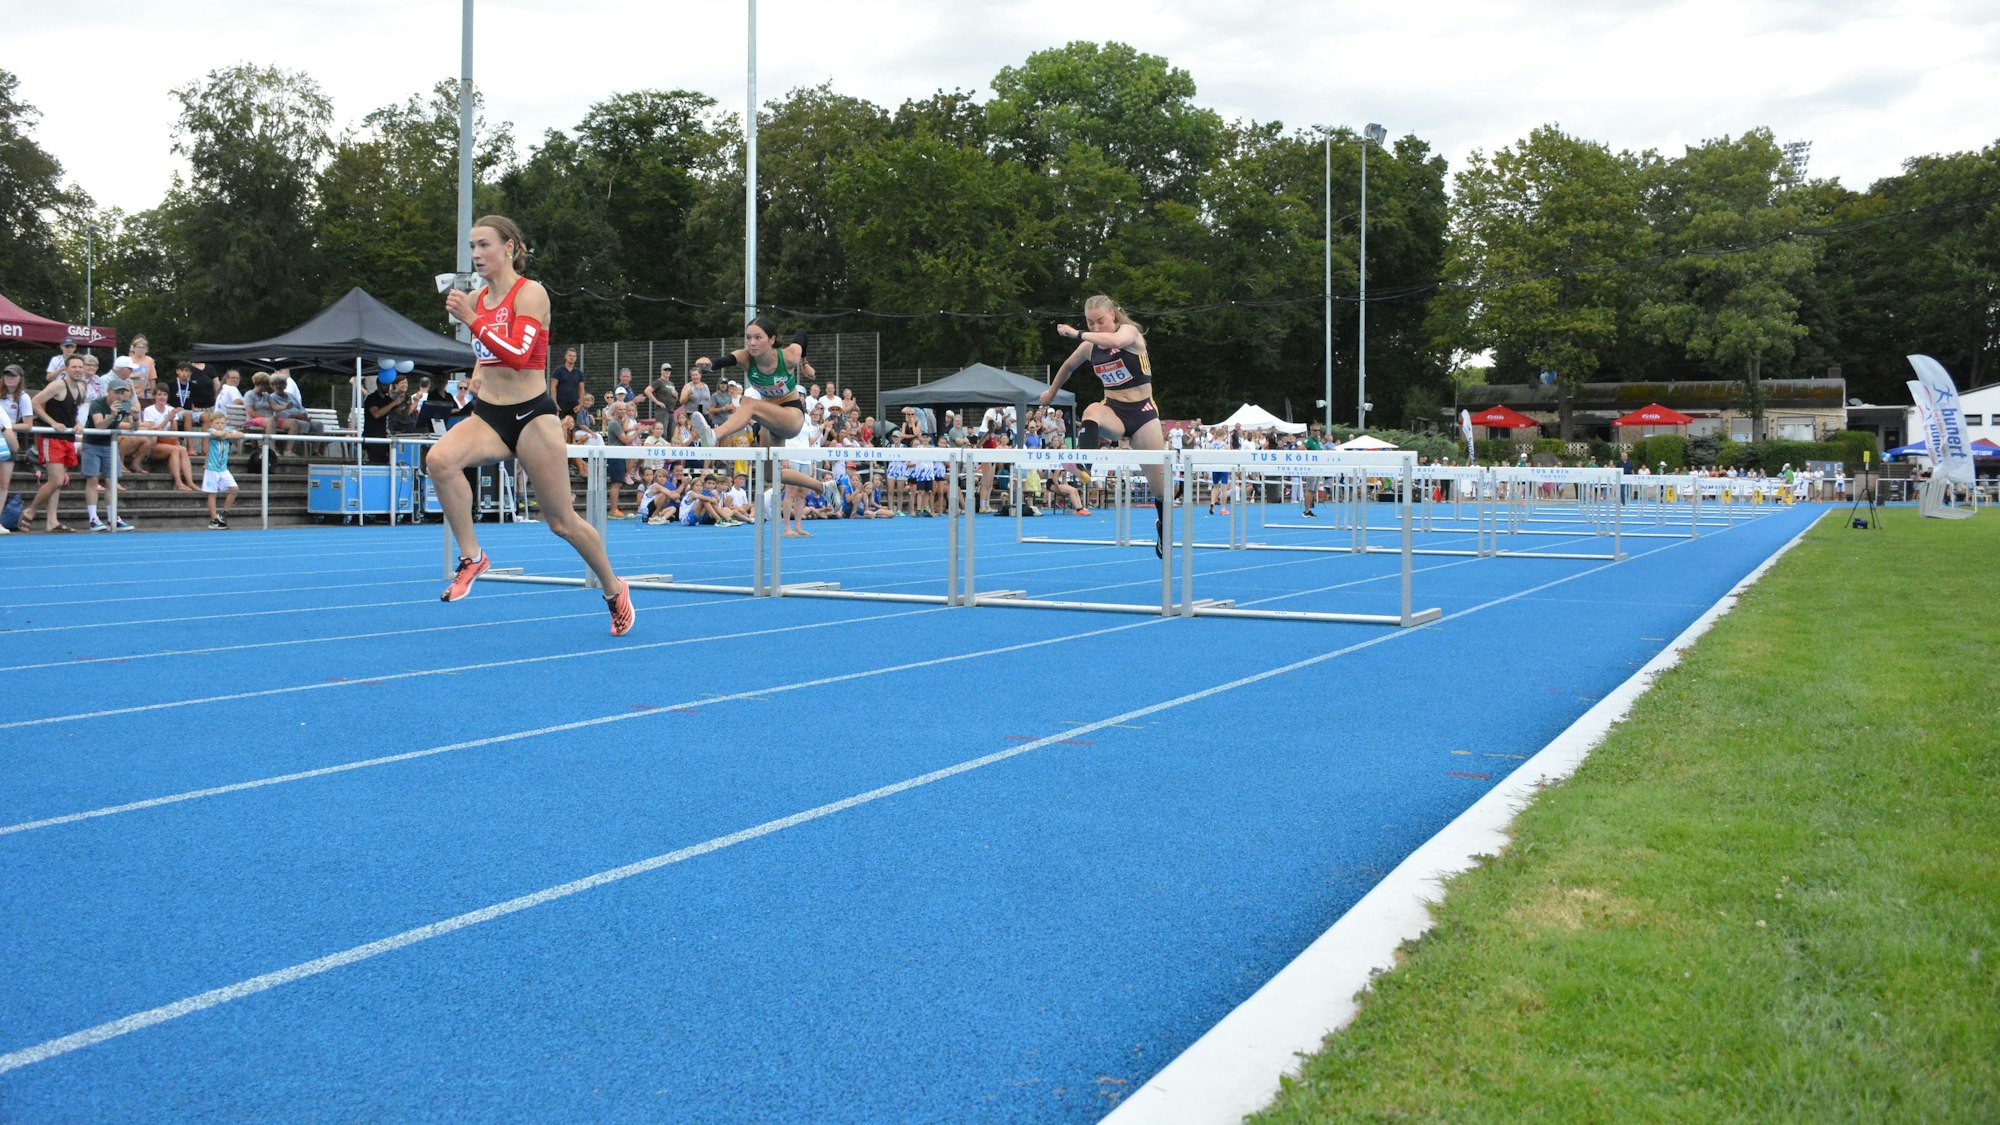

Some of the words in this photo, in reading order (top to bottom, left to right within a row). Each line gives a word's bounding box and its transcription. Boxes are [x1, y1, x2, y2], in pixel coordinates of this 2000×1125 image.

[0, 324, 22, 336] en
[68, 325, 90, 336] GAG
[1102, 370, 1125, 382] 916
[1941, 408, 1967, 459] bunert
[672, 449, 695, 457] Köln
[855, 450, 882, 458] Köln
[1058, 452, 1088, 460] Köln
[1251, 453, 1277, 461] TUS
[1286, 453, 1318, 461] Köln
